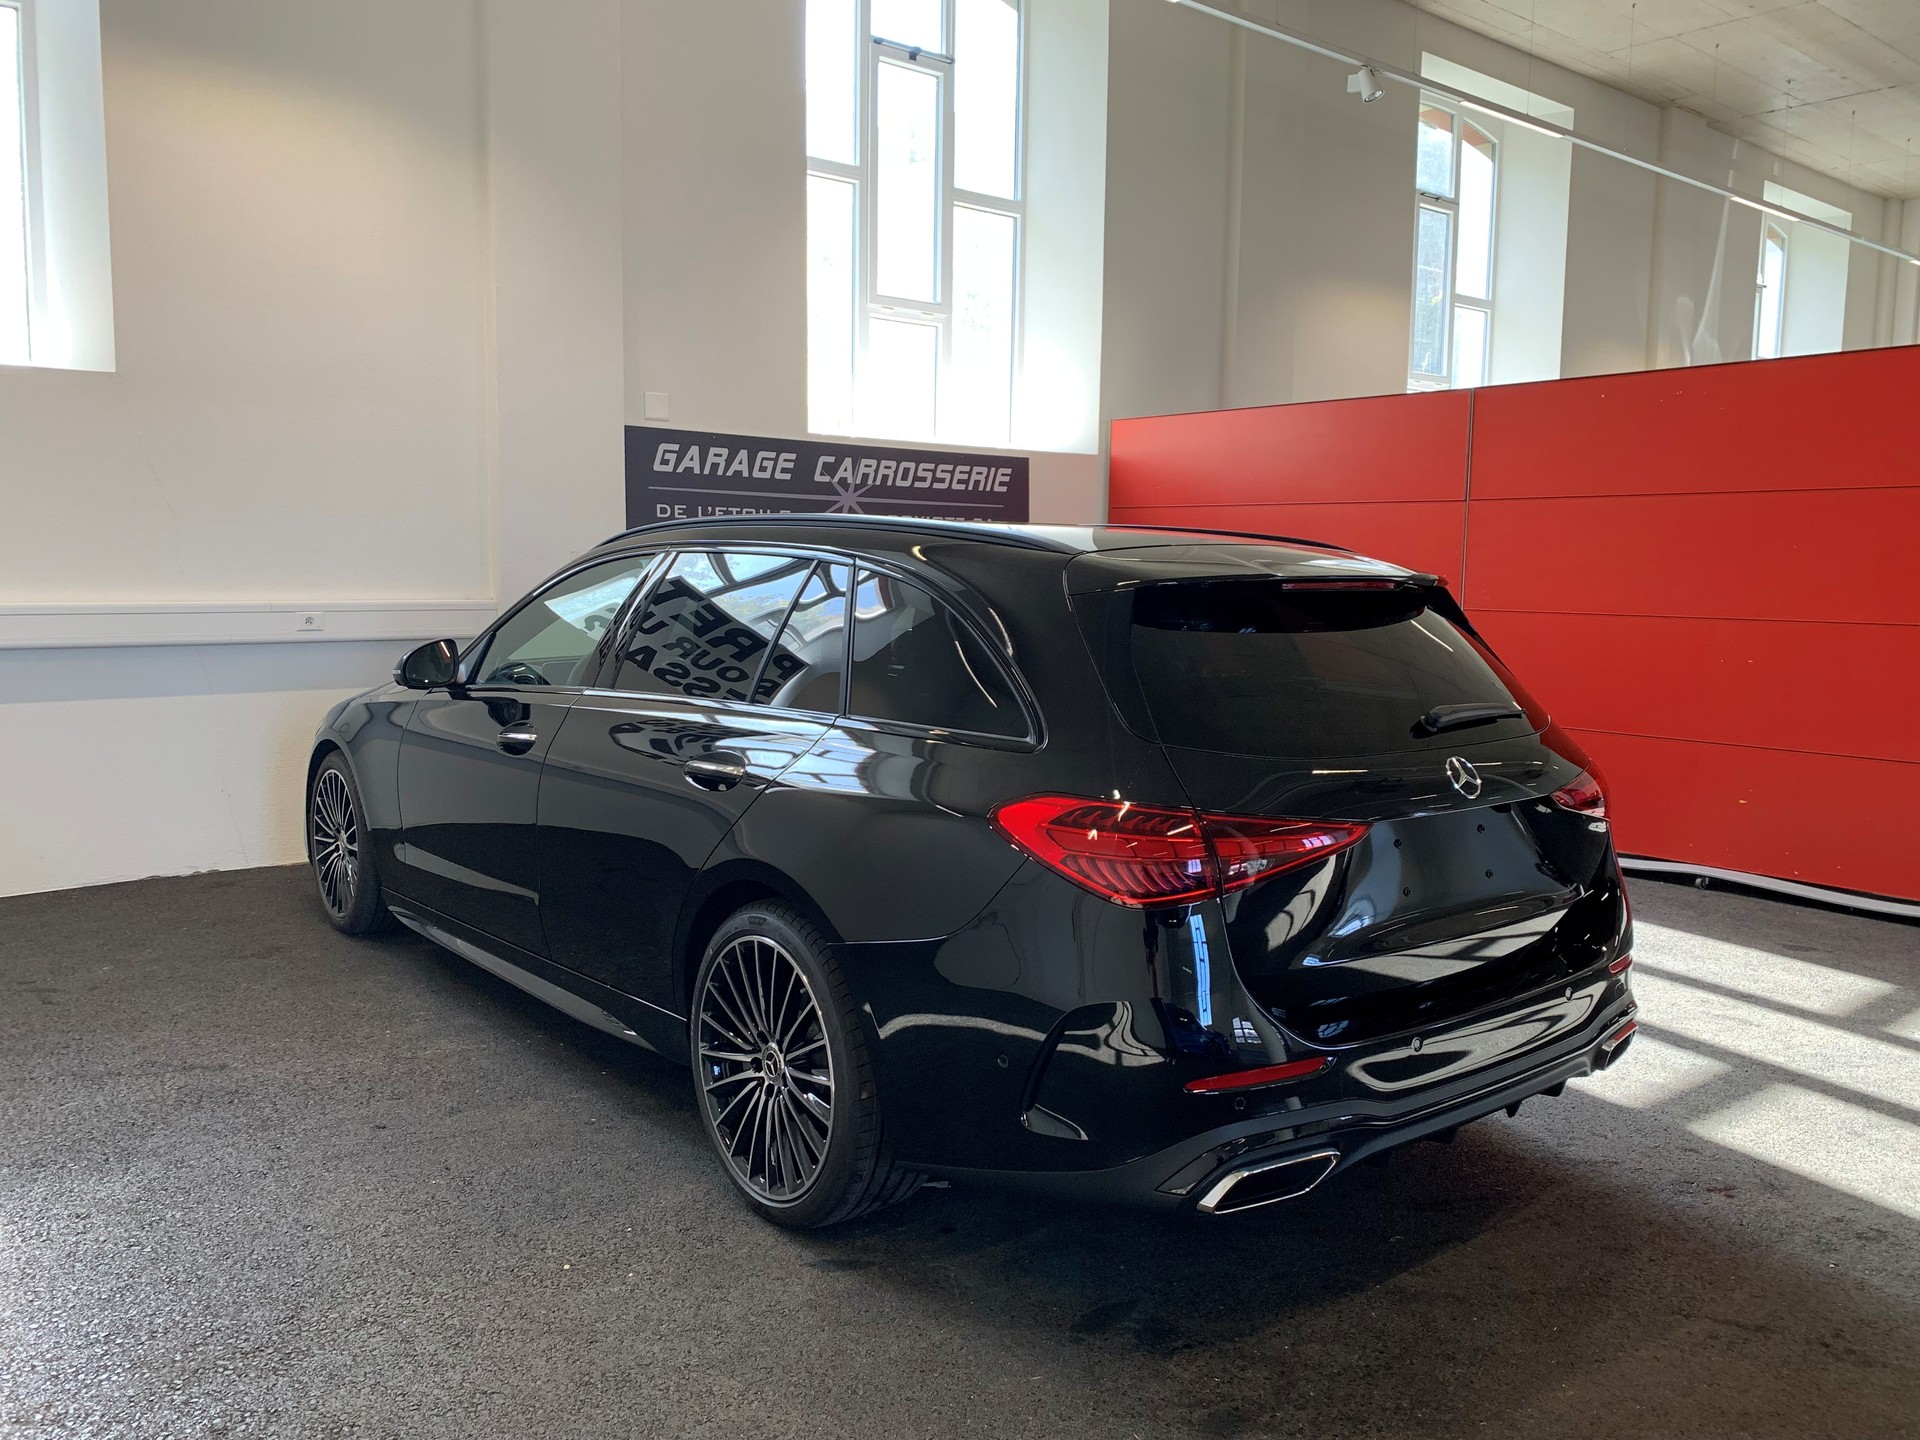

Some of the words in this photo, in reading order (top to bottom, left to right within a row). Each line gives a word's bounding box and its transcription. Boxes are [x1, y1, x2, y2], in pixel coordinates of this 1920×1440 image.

[653, 443, 797, 480] GARAGE
[814, 456, 1013, 493] CARROSSERIE
[656, 504, 687, 519] DE
